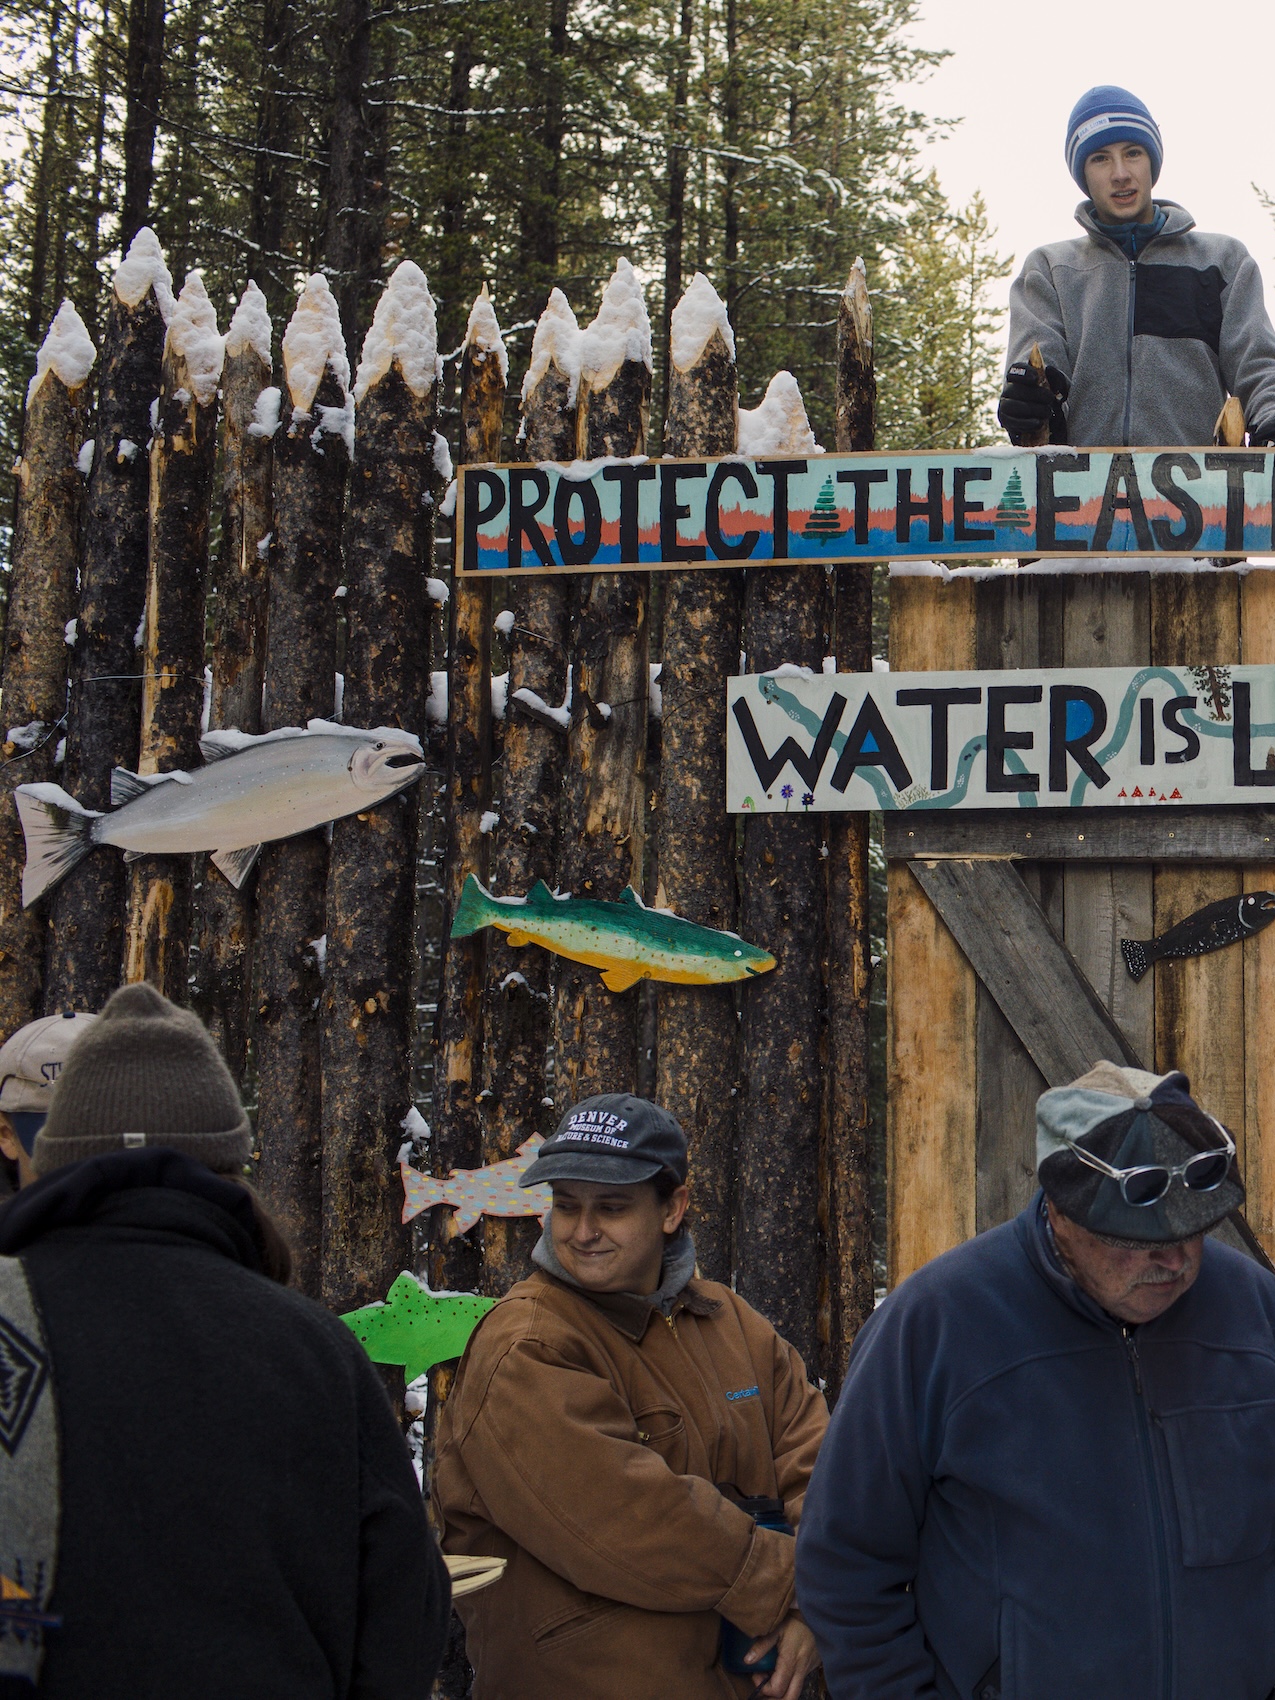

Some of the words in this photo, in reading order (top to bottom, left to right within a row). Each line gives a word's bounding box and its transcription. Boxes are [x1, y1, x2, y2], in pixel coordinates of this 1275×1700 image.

[463, 460, 808, 571] PROTECT
[837, 467, 996, 545] THE
[731, 684, 1112, 794] WATER
[1140, 695, 1202, 768] IS
[568, 1111, 628, 1131] DENVER
[569, 1123, 603, 1133] MUSEUM
[604, 1126, 617, 1135] OF
[555, 1131, 584, 1142] NATURE
[583, 1133, 590, 1142] &
[591, 1134, 629, 1149] SCIENCE
